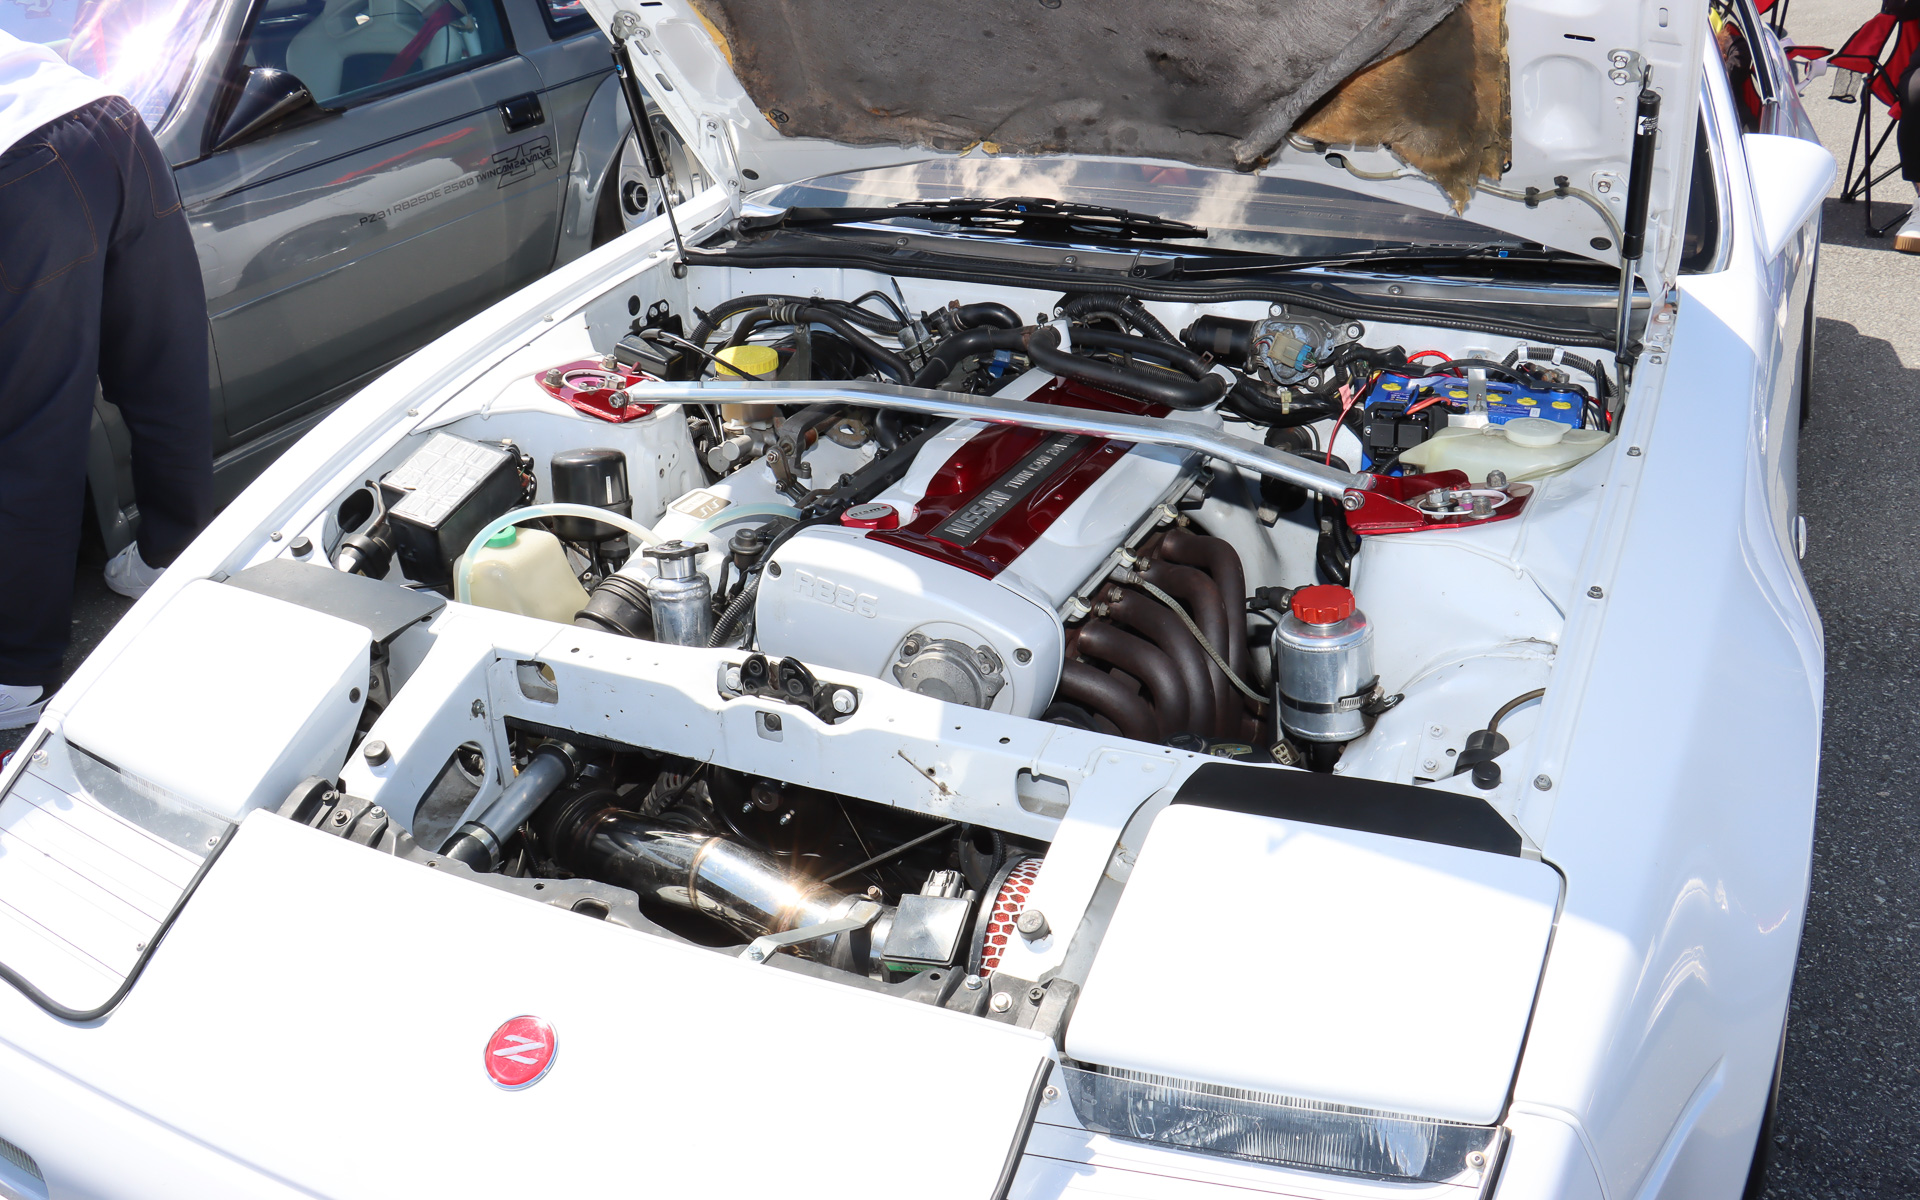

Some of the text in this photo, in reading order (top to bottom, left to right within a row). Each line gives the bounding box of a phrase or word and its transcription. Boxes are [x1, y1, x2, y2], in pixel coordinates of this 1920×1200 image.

[359, 208, 392, 227] PZ31
[393, 189, 442, 215] RB25DE
[443, 177, 474, 195] 2500
[944, 489, 1013, 538] NISSAN
[1005, 470, 1034, 489] TWIN
[1028, 455, 1053, 471] CAM
[793, 568, 879, 619] RB26
